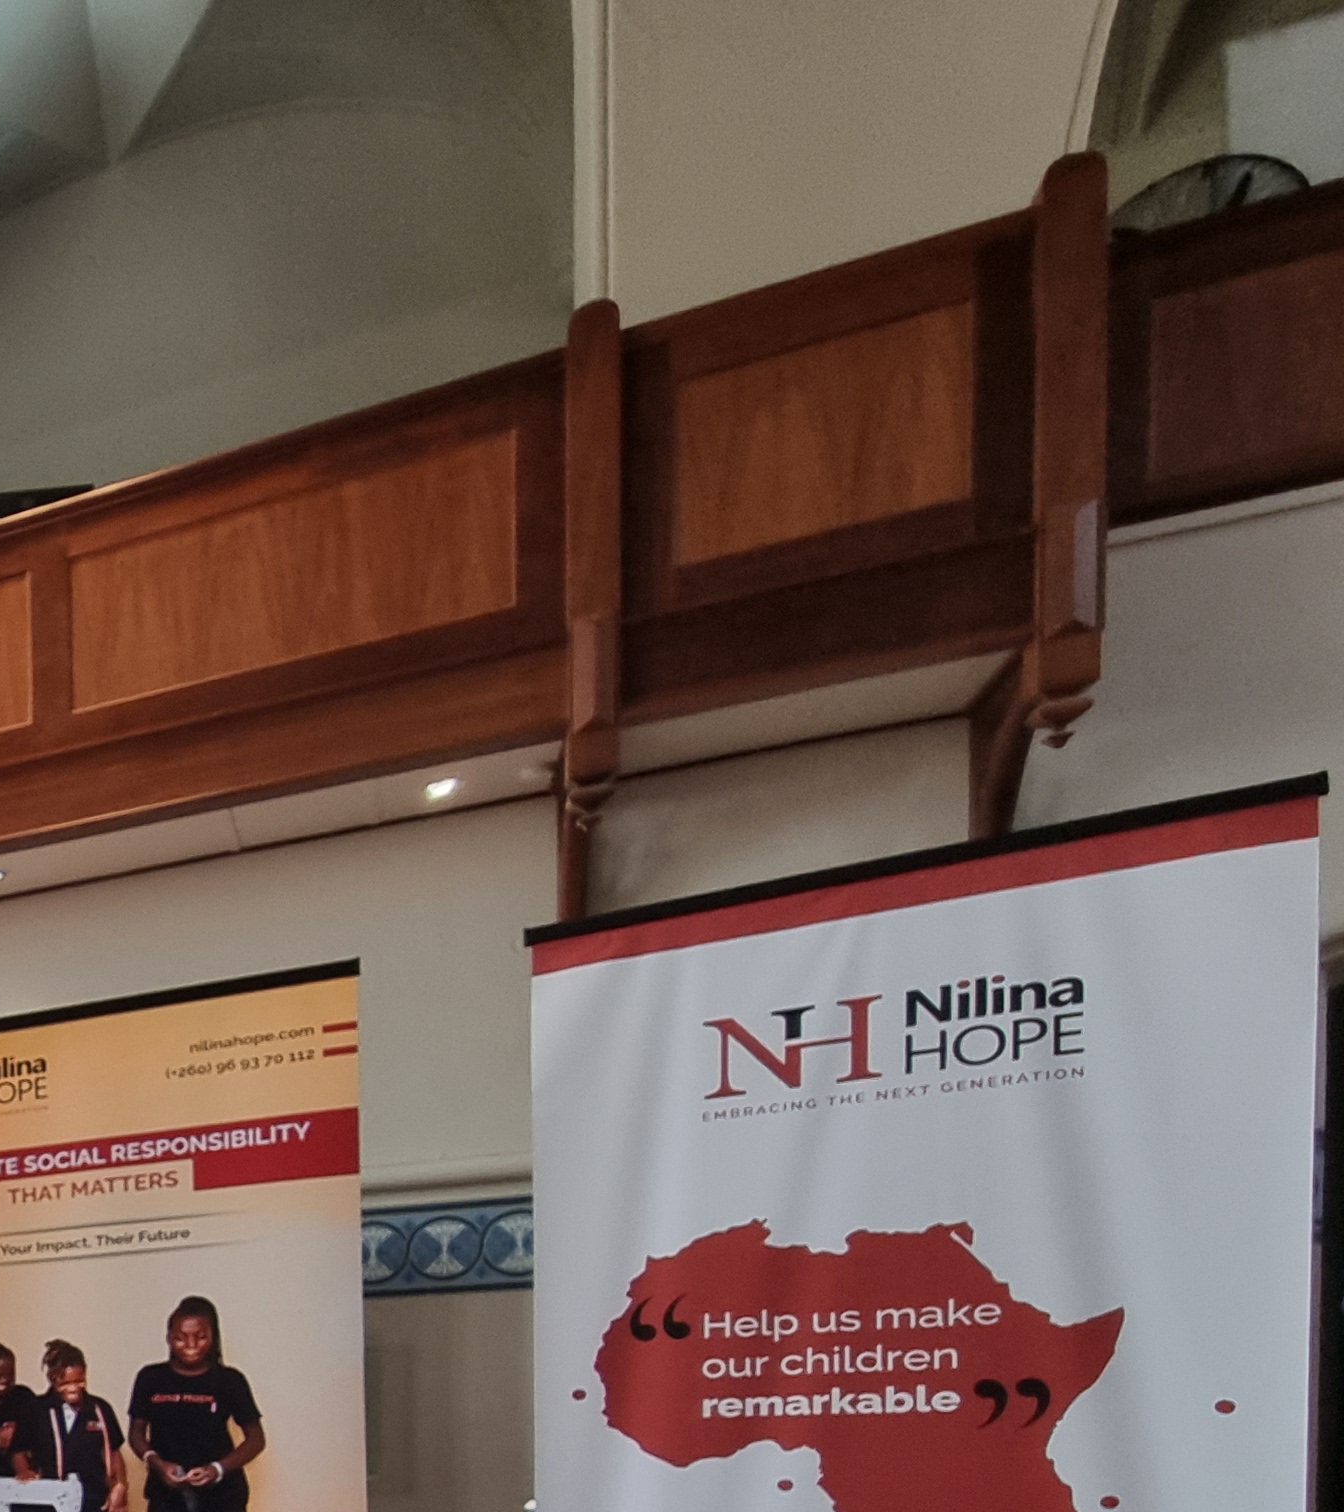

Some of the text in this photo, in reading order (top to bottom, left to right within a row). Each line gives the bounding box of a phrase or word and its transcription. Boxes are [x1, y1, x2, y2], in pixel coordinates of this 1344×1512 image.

[905, 974, 1085, 1028] Nilina
[189, 1026, 315, 1054] nilinahope.com
[905, 1012, 1085, 1075] HOPE
[165, 1049, 315, 1080] (+260) 96 93 70 112
[702, 1066, 1086, 1122] EMBRACING THE NEXT GENERATION
[23, 1145, 107, 1175] SOCIAL
[110, 1120, 311, 1164] RESPONSIBILITY
[7, 1170, 179, 1206] THAT MATTERS
[0, 1241, 33, 1259] Your
[95, 1231, 134, 1249] Their
[137, 1227, 192, 1246] Future
[701, 1298, 1003, 1342] Help us make
[701, 1343, 960, 1379] our children
[701, 1384, 962, 1419] remarkable
